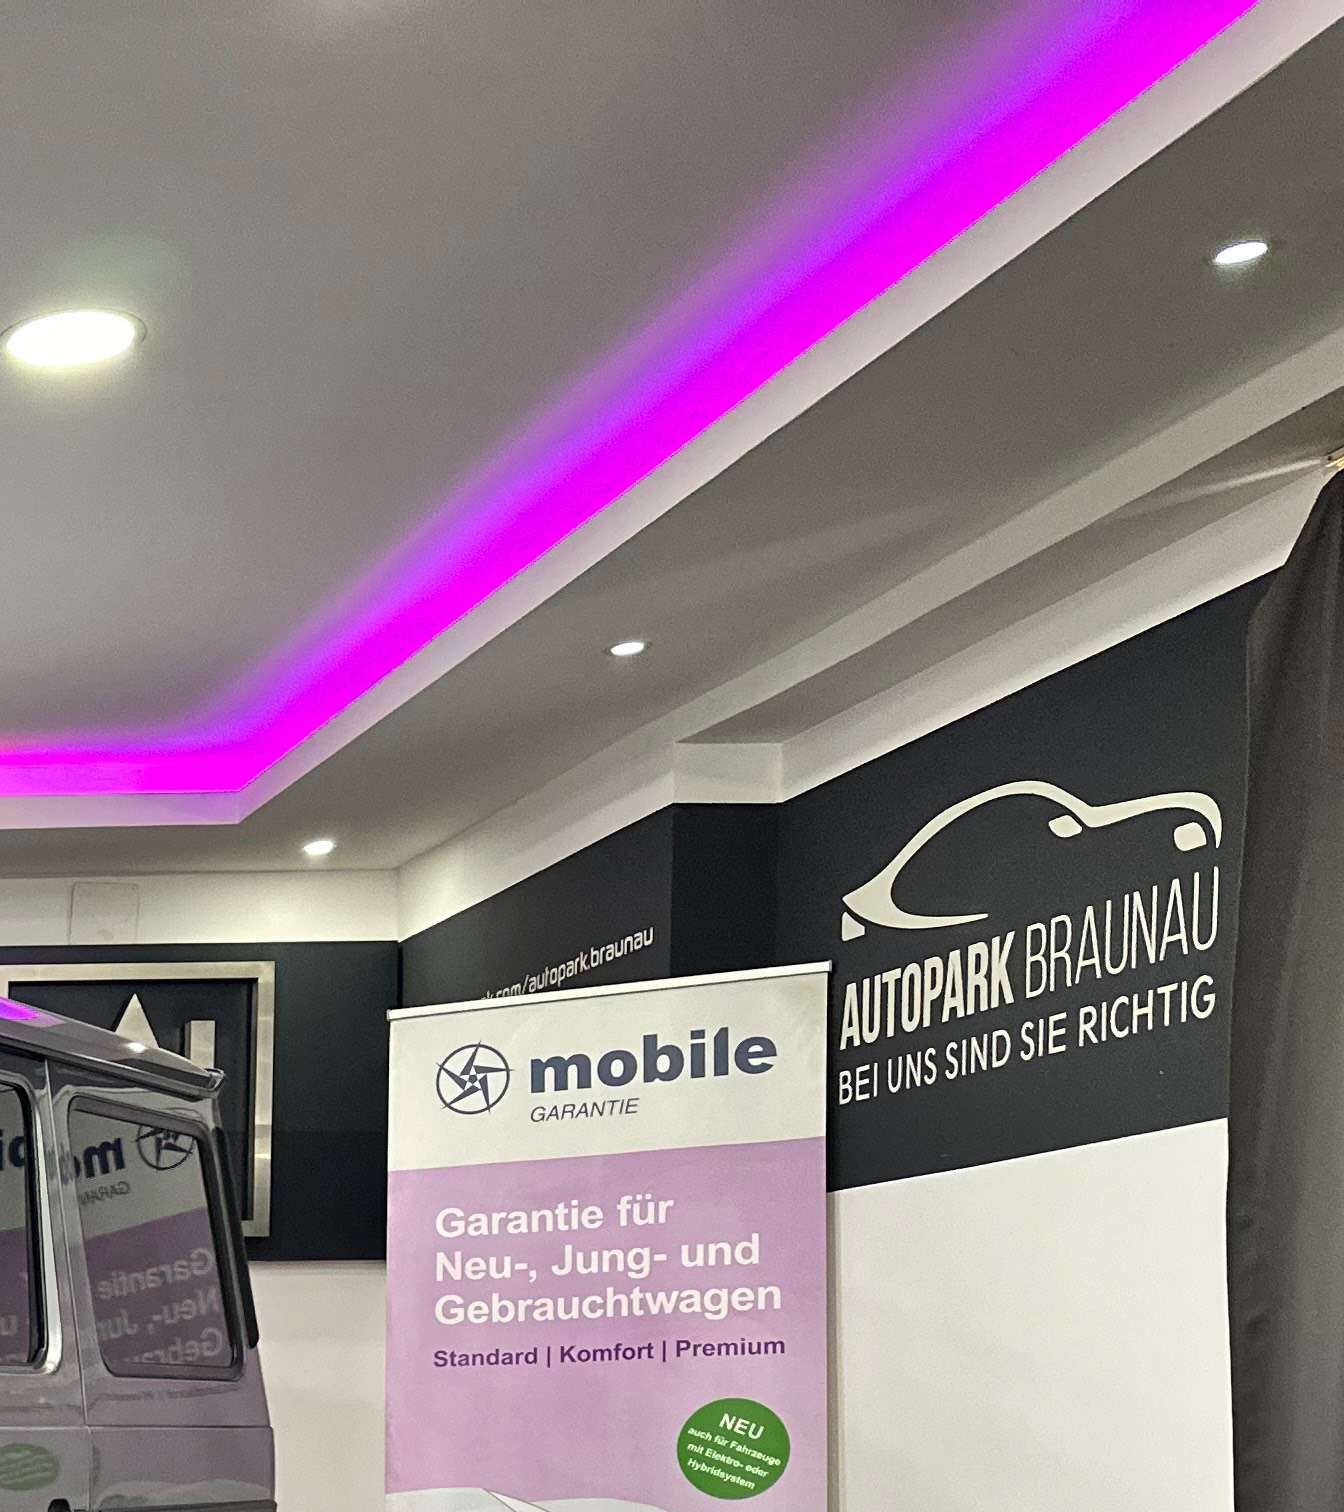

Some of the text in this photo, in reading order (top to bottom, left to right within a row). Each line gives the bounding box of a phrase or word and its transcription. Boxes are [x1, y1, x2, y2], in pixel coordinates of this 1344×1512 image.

[840, 866, 1219, 1050] AUTOPARK BRAUNAU
[530, 1027, 777, 1094] mobile
[839, 975, 1216, 1104] BEI UNS SIND SIE RICHTIG
[530, 1098, 640, 1123] GARANTIE
[435, 1193, 674, 1238] Garantie für
[435, 1233, 761, 1283] Neu-, Jung- und
[434, 1284, 782, 1326] Gebrauchtwagen
[433, 1347, 539, 1367] Standard
[559, 1342, 655, 1364] Komfort
[675, 1337, 786, 1358] Premium
[719, 1413, 765, 1439] NEU
[687, 1443, 705, 1455] mit
